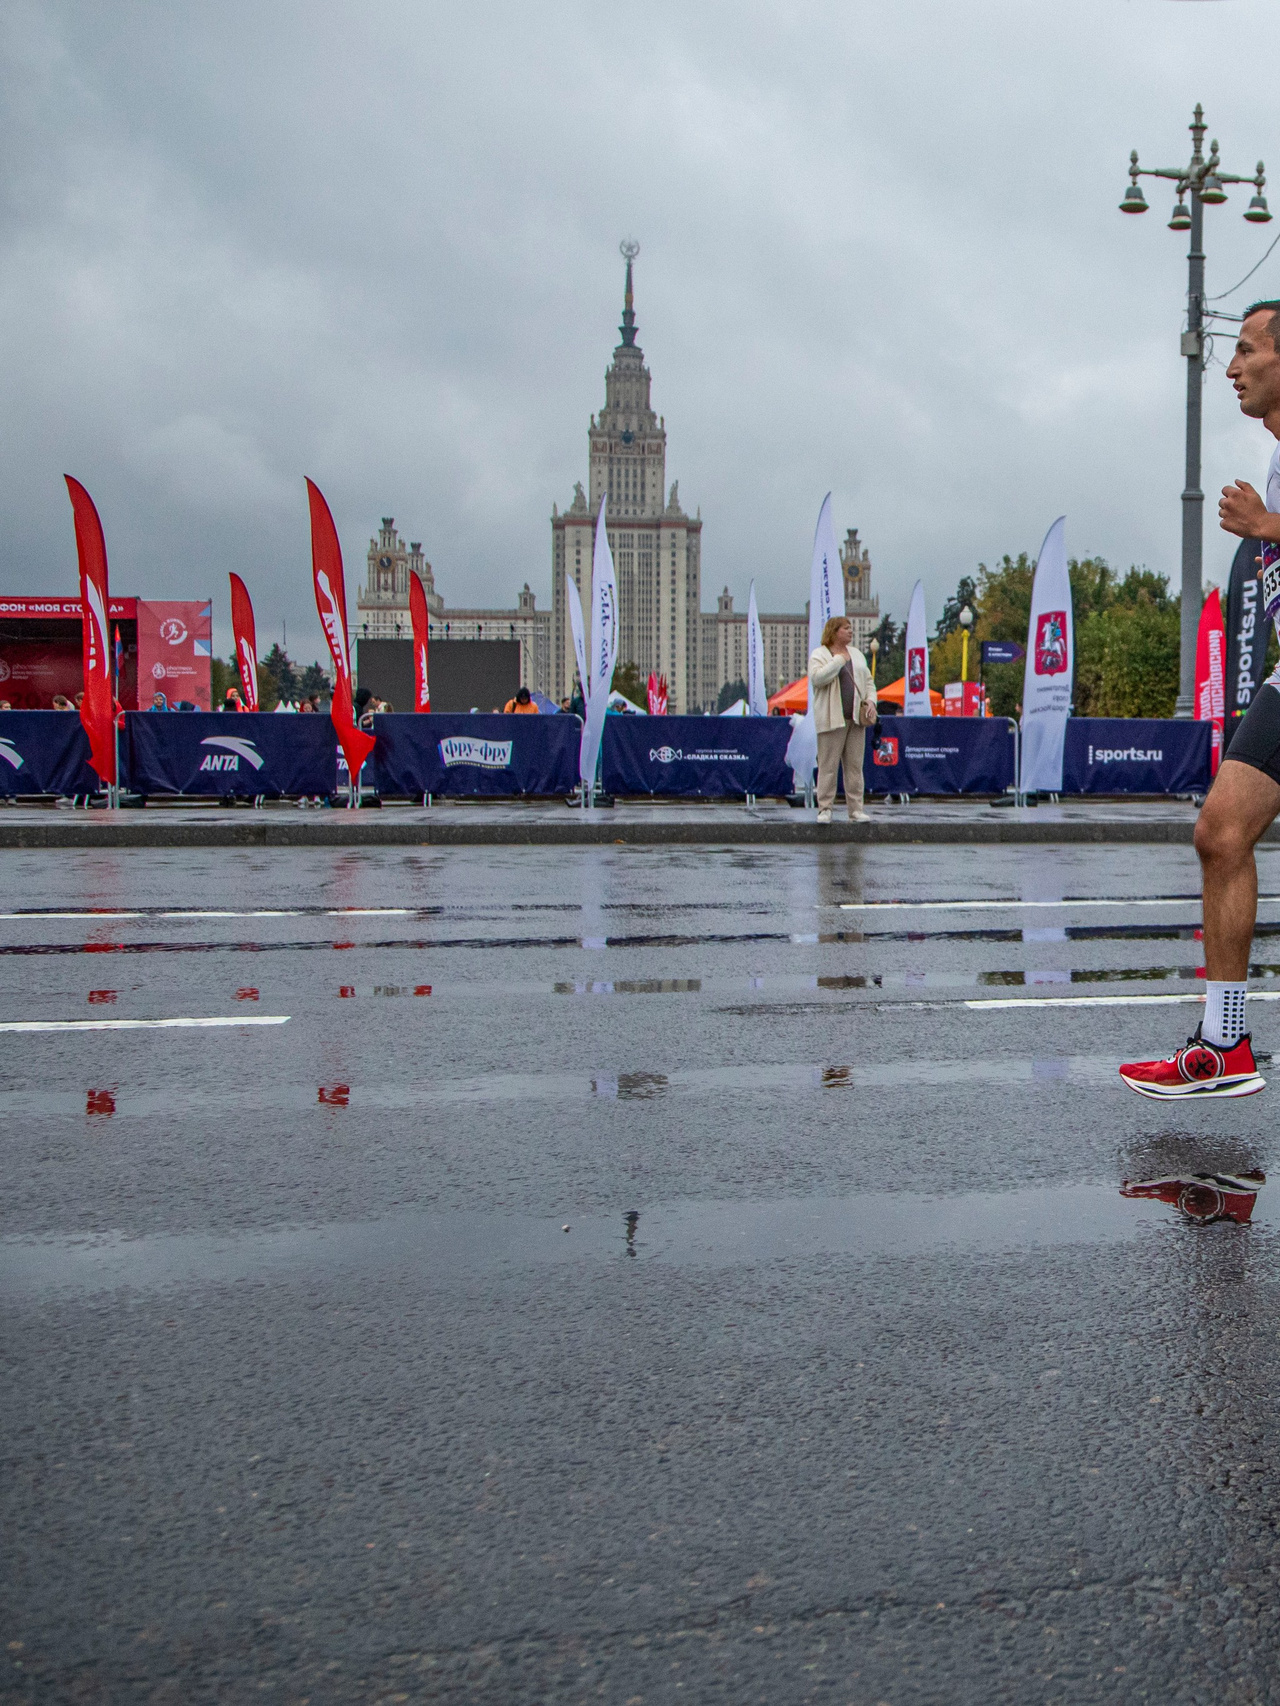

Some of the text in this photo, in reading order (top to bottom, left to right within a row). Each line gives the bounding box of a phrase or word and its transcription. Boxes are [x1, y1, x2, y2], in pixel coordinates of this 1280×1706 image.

[29, 604, 60, 612] «МОЯ
[63, 604, 124, 612] СТОА»
[1236, 579, 1258, 705] sports.ru
[445, 740, 507, 761] фру-фру
[1095, 747, 1163, 764] sports.ru
[200, 755, 239, 771] ANTA
